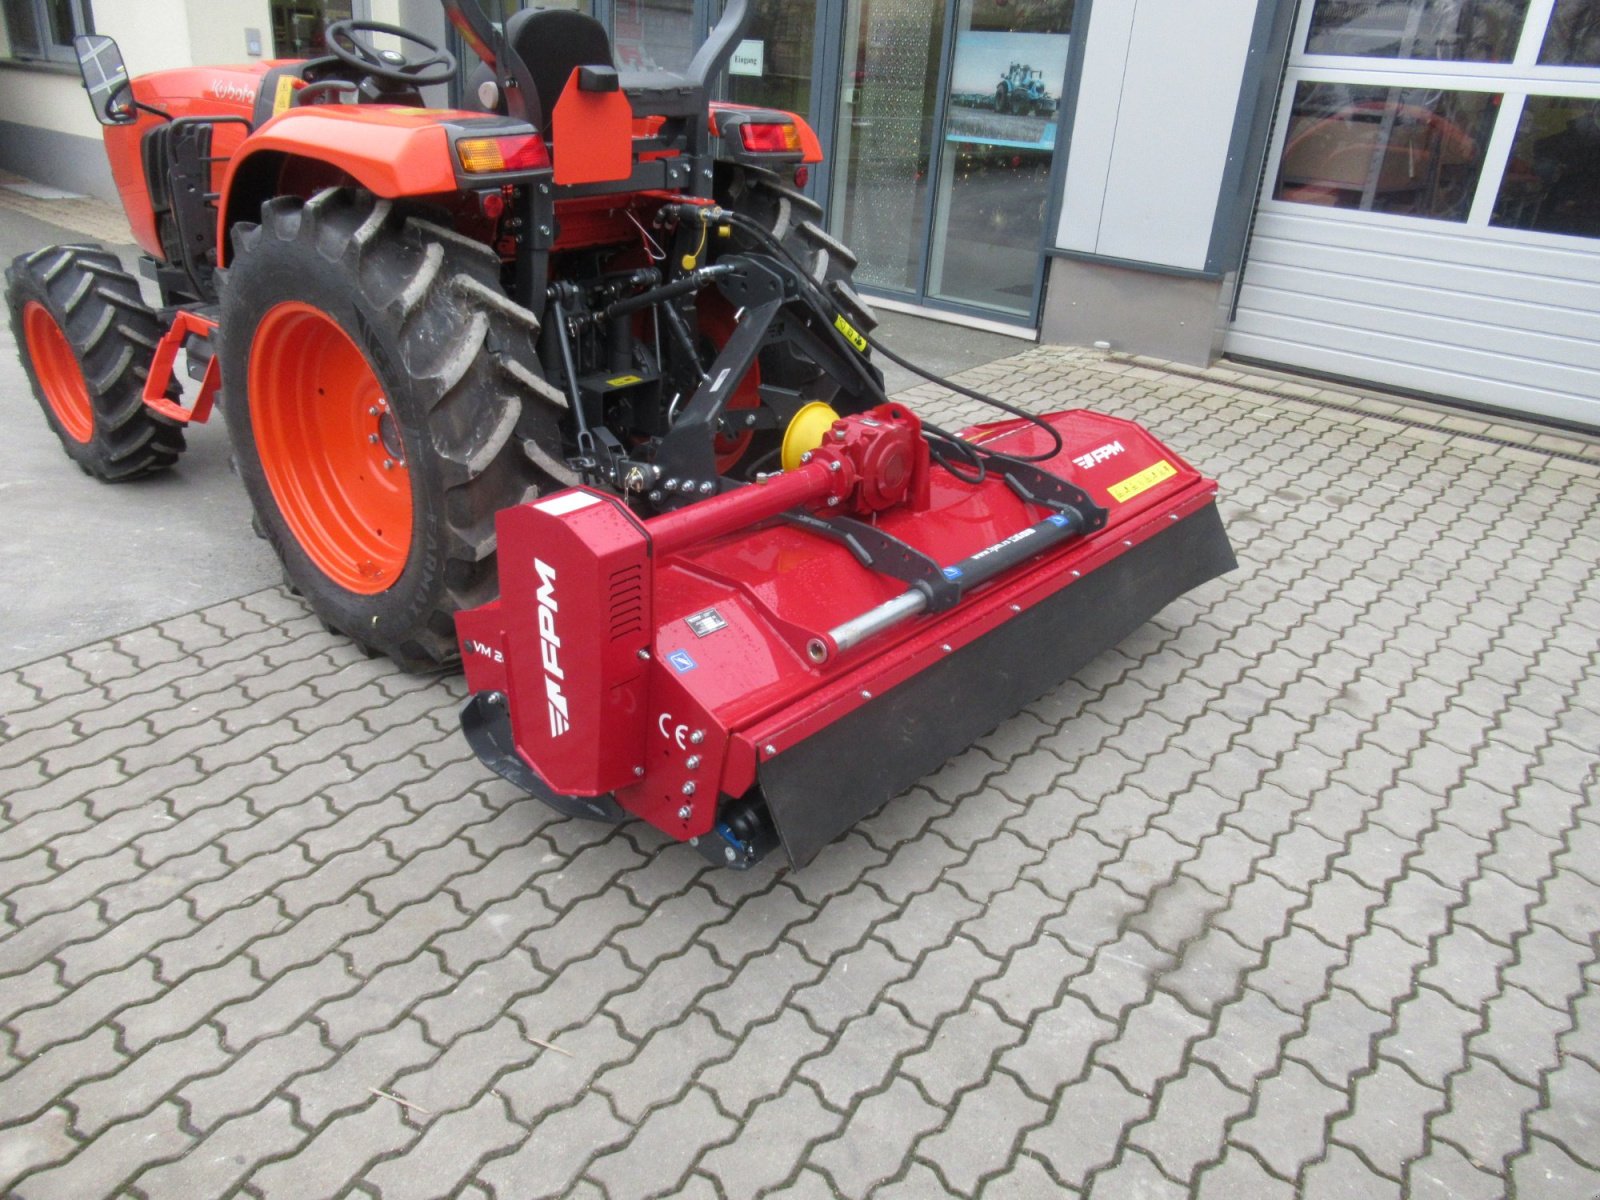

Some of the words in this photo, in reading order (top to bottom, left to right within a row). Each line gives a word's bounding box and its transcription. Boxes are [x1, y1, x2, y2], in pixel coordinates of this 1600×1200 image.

[734, 55, 758, 66] Eingang
[211, 79, 255, 104] Kubota
[1090, 440, 1125, 464] FPM
[534, 556, 565, 681] FPM
[473, 640, 491, 658] VM
[659, 712, 689, 751] CE
